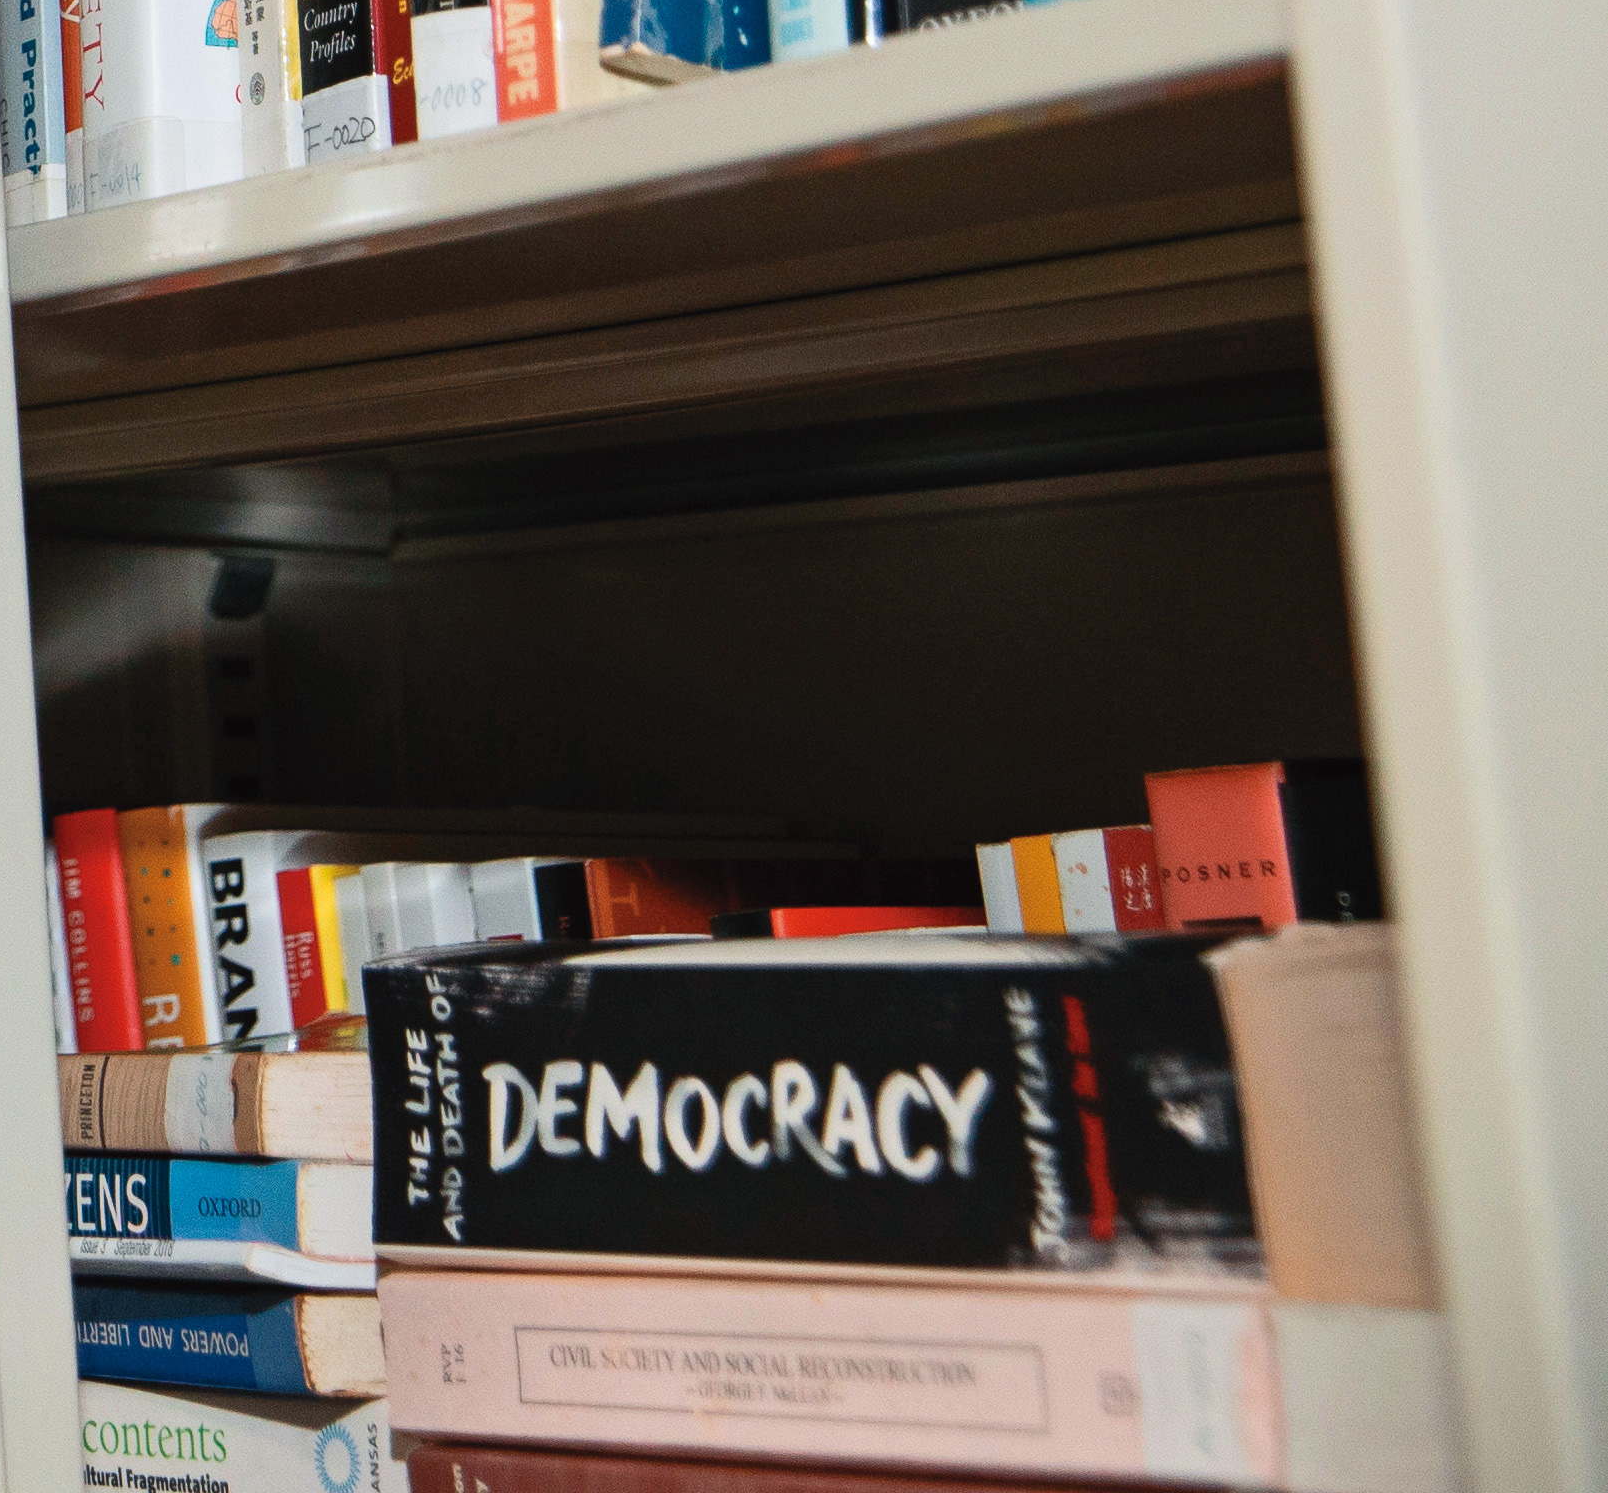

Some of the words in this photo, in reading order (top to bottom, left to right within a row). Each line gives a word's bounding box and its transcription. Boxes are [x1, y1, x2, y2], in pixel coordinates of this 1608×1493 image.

[303, 0, 359, 33] Country
[309, 31, 357, 63] Profiles
[69, 909, 96, 1024] COLLINS
[405, 1025, 434, 1114] LIFE
[434, 1031, 464, 1158] DEATH
[79, 1063, 95, 1142] PRINCETON
[482, 1059, 993, 1183] DEMOCRACY
[406, 1124, 434, 1207] THE
[197, 1196, 263, 1219] OXFORD
[440, 1166, 465, 1242] AND
[137, 1324, 174, 1350] AND
[179, 1327, 250, 1358] POWERS
[82, 1418, 227, 1463] contents
[125, 1467, 230, 1493] Fragmentation
